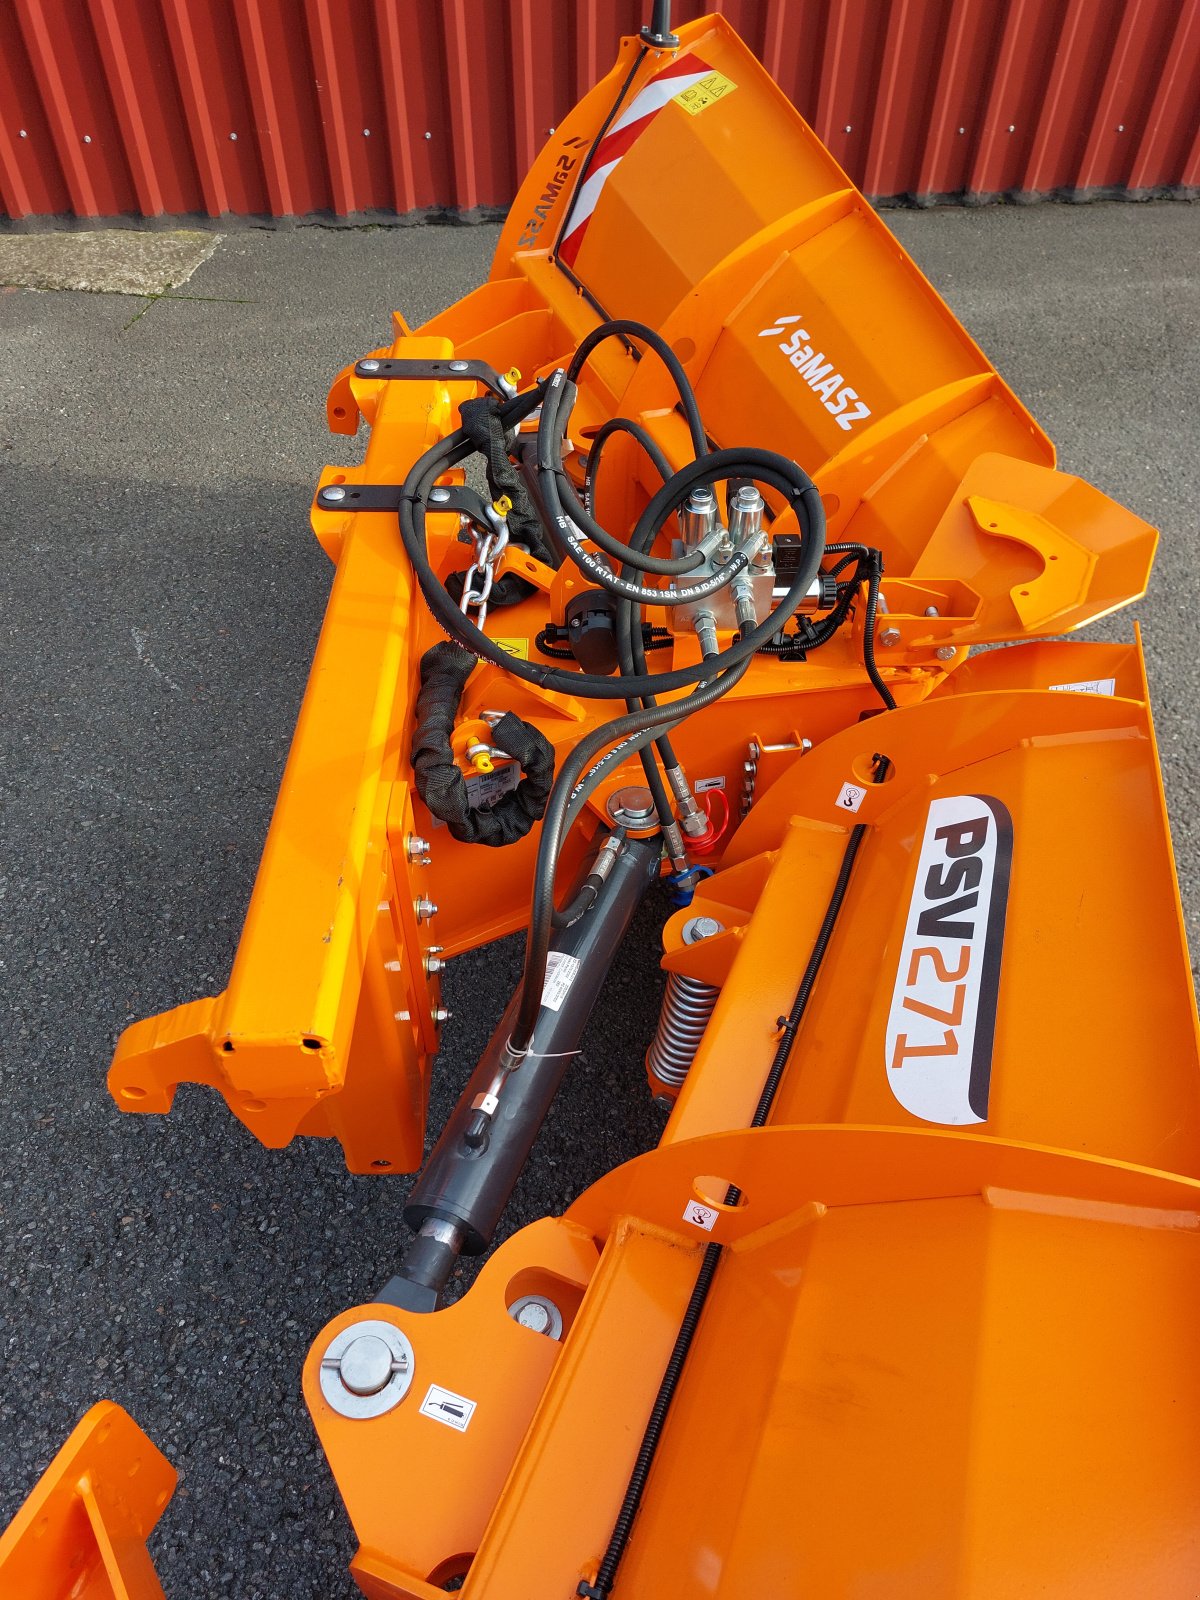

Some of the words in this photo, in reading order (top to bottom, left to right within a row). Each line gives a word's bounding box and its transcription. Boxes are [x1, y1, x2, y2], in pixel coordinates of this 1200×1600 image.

[778, 328, 872, 431] SaMASZ
[556, 515, 567, 529] HB
[567, 535, 584, 554] SAE
[582, 554, 596, 568] 100
[595, 566, 619, 584] R1AT
[626, 583, 639, 594] EN
[641, 587, 657, 597] 853
[660, 590, 677, 598] 1SN
[681, 588, 694, 597] DN
